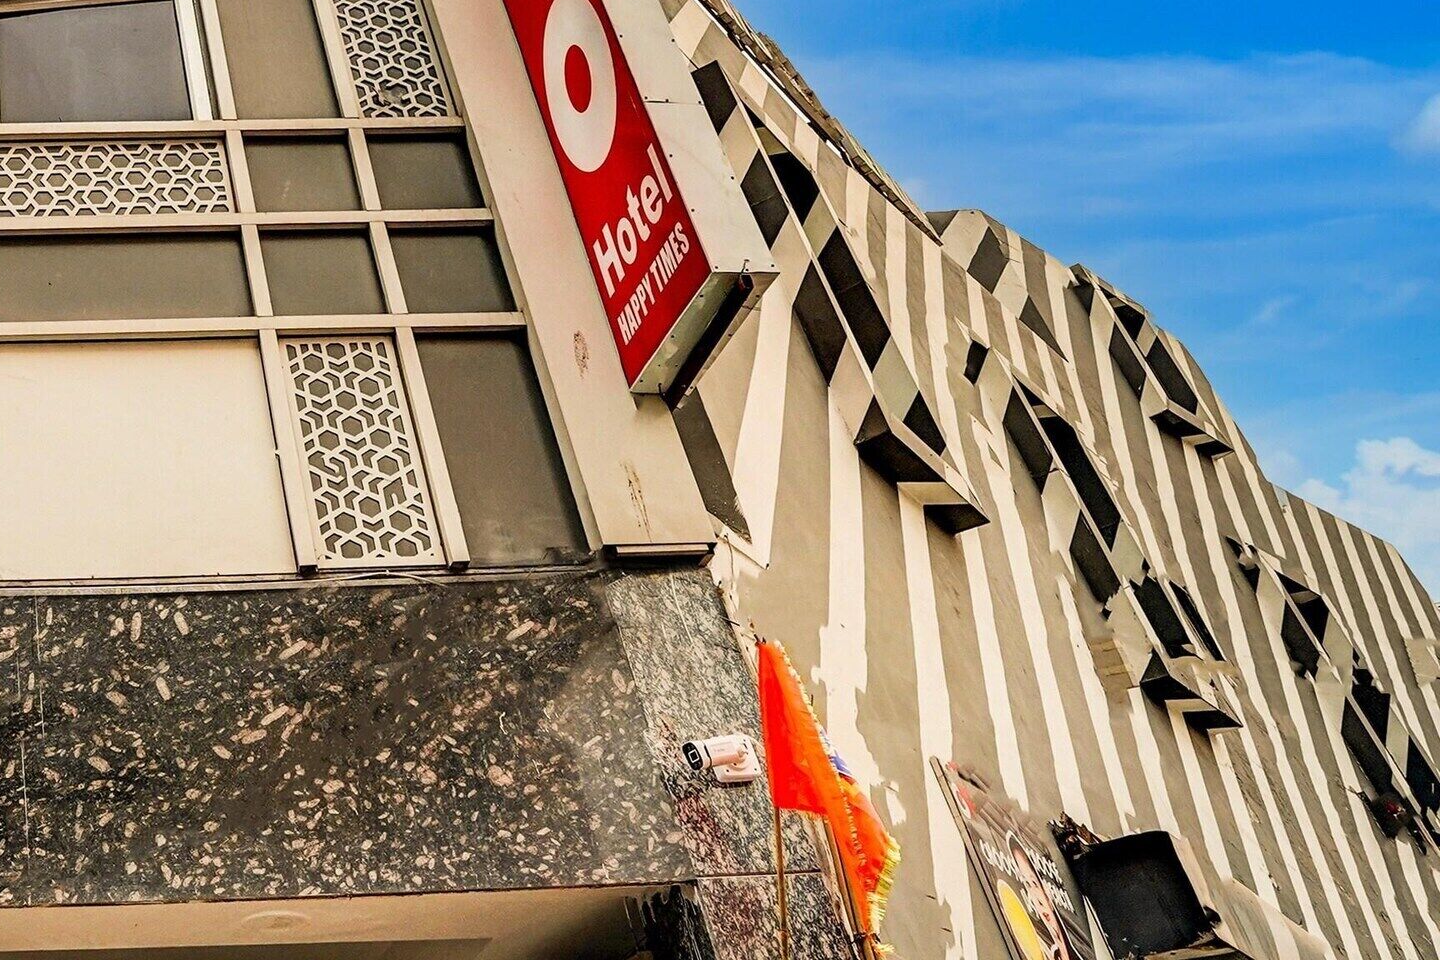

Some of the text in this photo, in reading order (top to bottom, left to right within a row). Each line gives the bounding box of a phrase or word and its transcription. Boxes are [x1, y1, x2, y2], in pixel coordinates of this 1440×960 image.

[593, 142, 673, 299] Hotel
[617, 221, 690, 346] HAPPY TIMES
